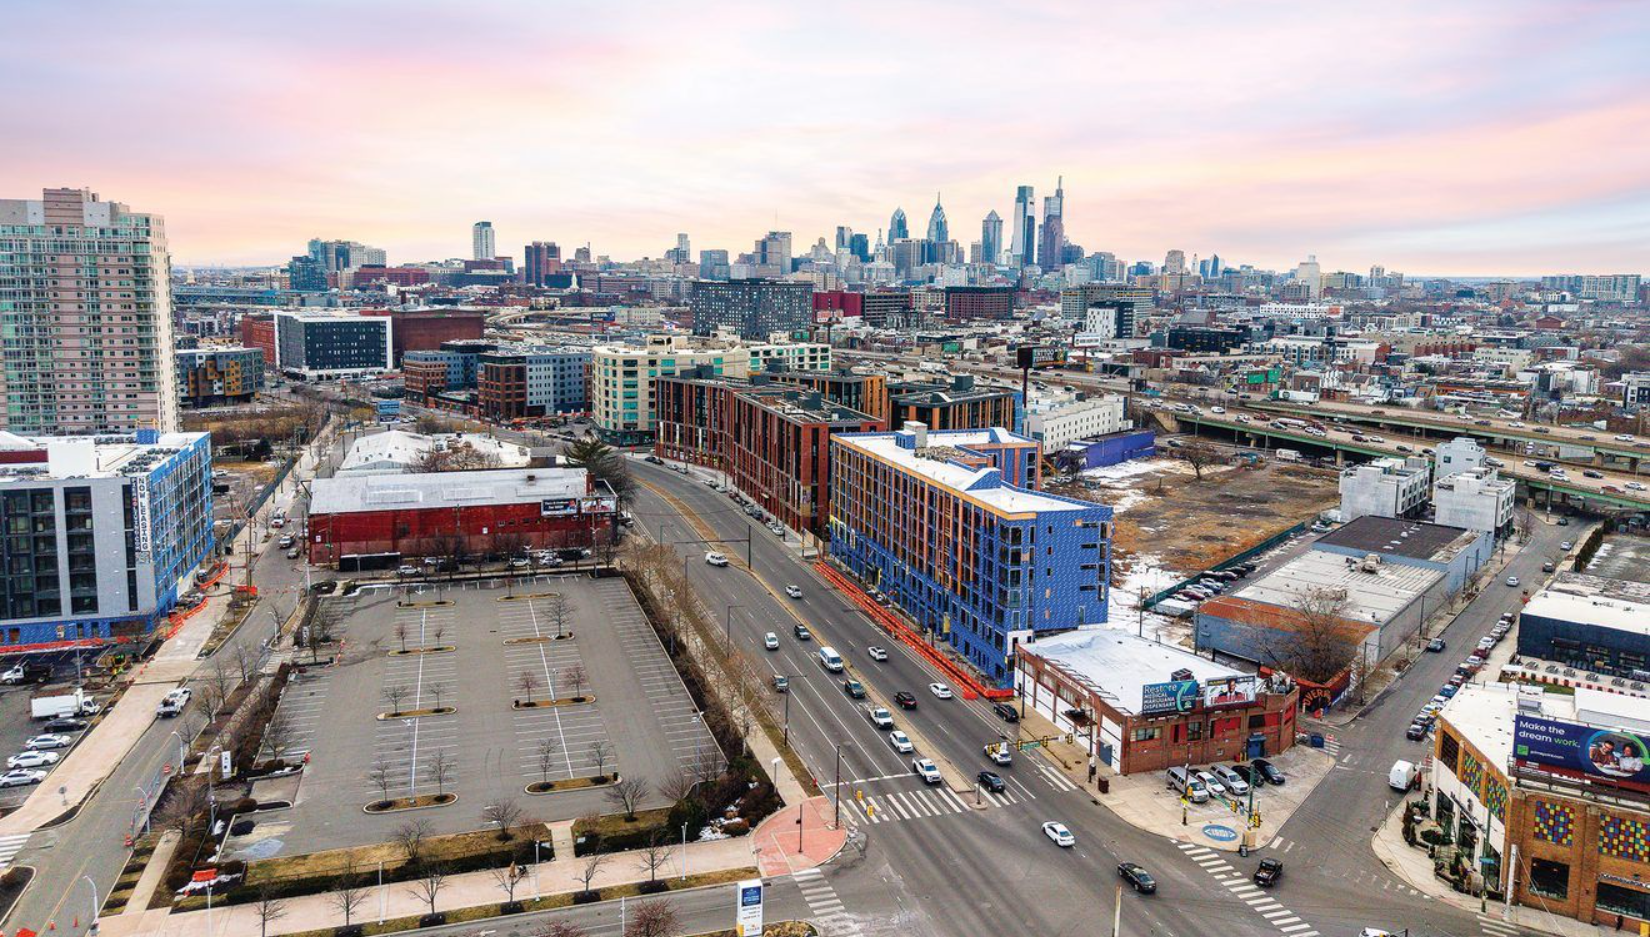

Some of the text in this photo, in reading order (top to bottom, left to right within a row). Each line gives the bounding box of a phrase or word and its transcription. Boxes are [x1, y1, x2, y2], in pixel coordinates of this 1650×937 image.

[1144, 685, 1177, 694] Restore
[1144, 696, 1175, 704] MARIJUANA
[1144, 702, 1175, 710] DISPENSARY
[1519, 721, 1565, 735] Make the
[1518, 731, 1580, 748] dream work.
